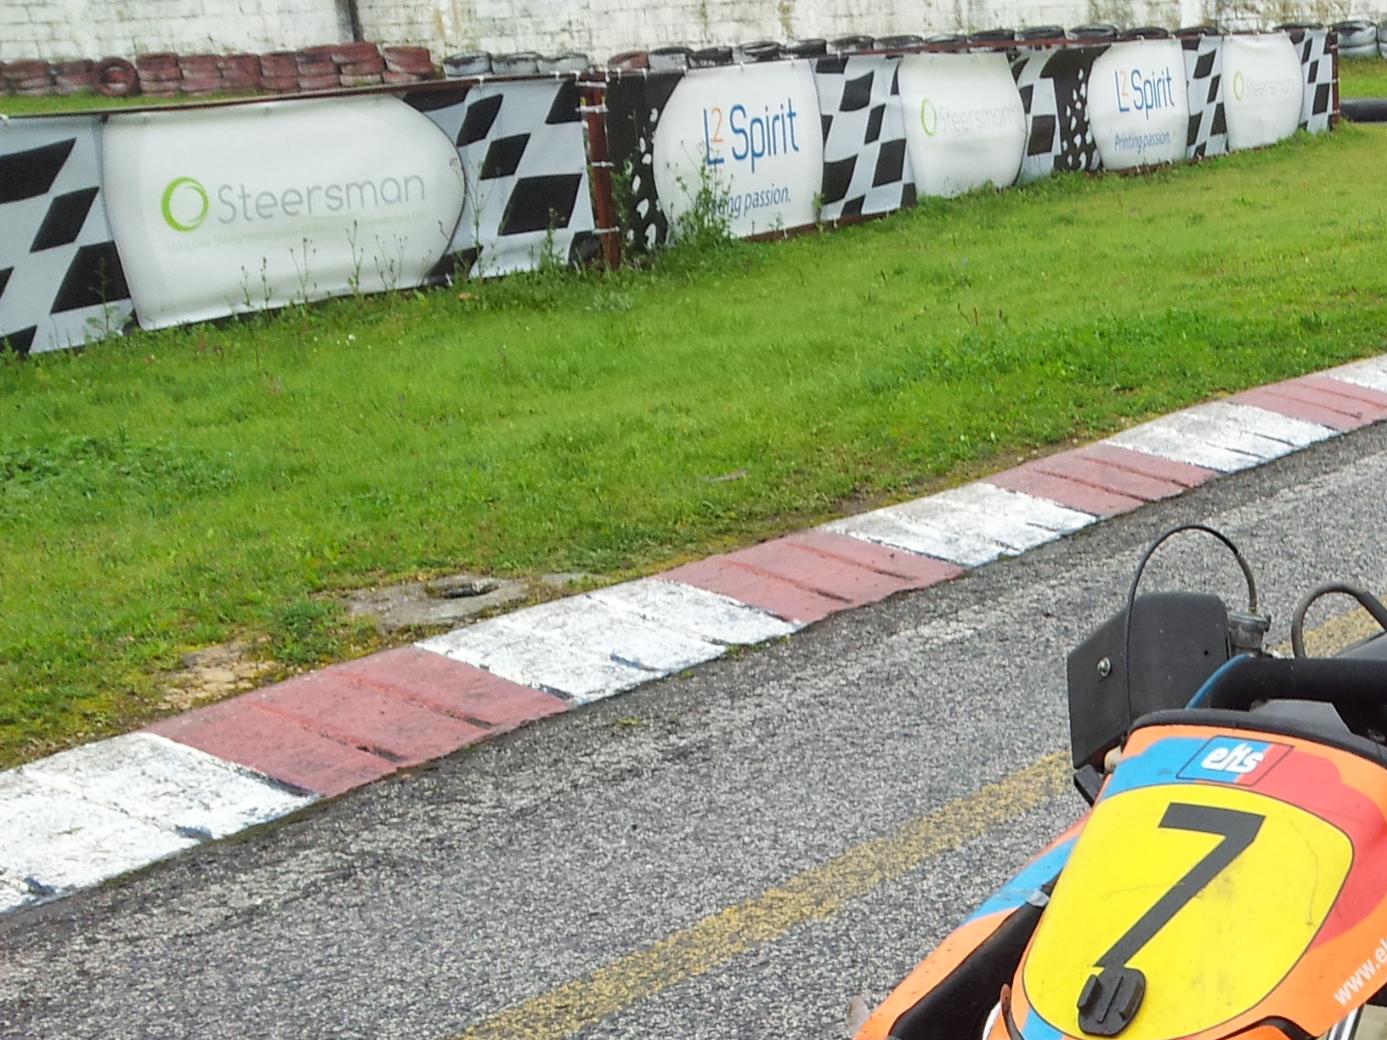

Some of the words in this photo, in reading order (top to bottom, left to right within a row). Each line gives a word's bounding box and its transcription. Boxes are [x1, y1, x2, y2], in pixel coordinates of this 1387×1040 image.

[1131, 66, 1175, 120] Spirit
[729, 98, 799, 173] Spirit
[938, 104, 1014, 134] Steersman
[1115, 132, 1142, 153] Printing
[218, 175, 425, 225] Steersman
[743, 184, 792, 217] passion.
[1092, 802, 1266, 970] 7
